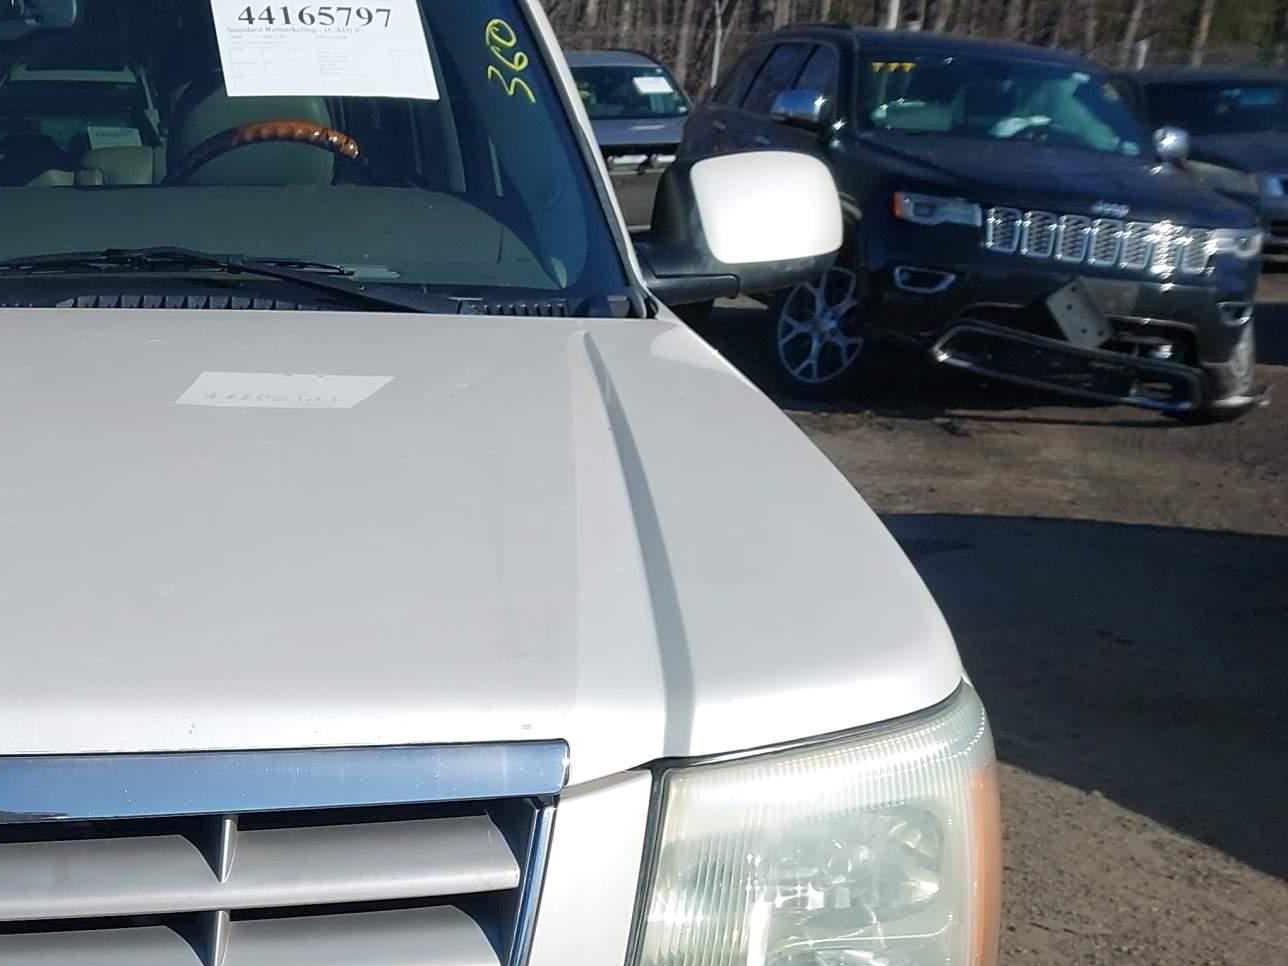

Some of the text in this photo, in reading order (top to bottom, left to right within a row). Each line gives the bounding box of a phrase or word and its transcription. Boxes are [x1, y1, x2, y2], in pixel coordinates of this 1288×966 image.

[238, 5, 392, 28] 44165797
[264, 26, 318, 35] Remarketing
[485, 18, 536, 103] 360
